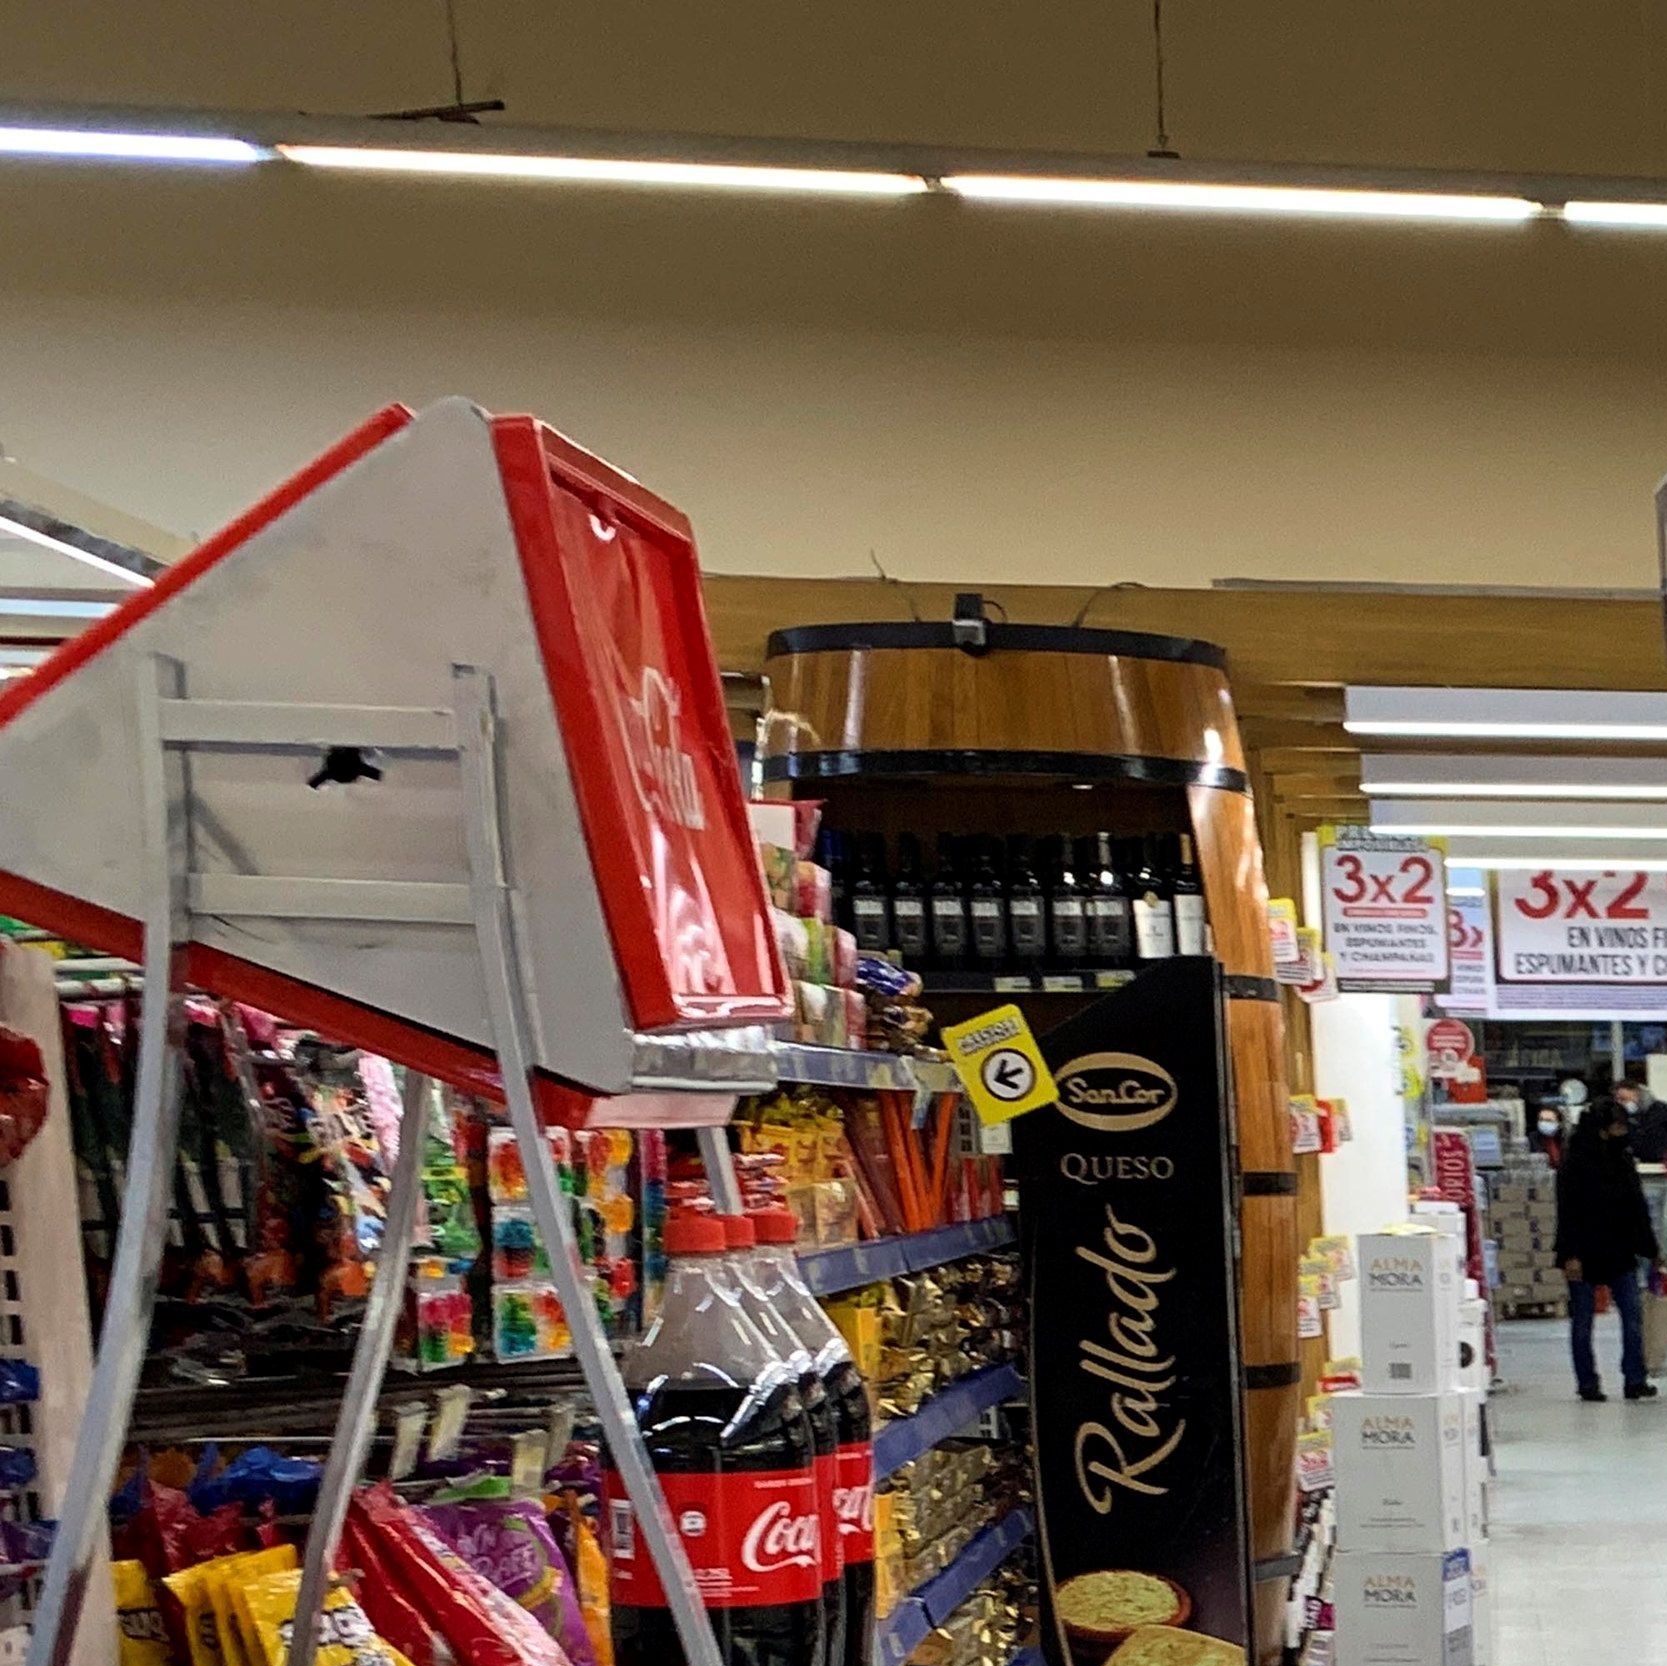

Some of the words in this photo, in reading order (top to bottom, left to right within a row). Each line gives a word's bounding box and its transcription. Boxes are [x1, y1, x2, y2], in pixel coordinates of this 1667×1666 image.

[1333, 854, 1434, 904] 3x2
[1514, 870, 1649, 920] 3x2
[1567, 927, 1590, 949] EN
[1598, 927, 1648, 949] VINOS
[1515, 952, 1630, 976] ESPUMANTES
[1636, 953, 1648, 976] Y
[1060, 1152, 1174, 1185] QUESO
[1075, 1204, 1185, 1515] Rallado
